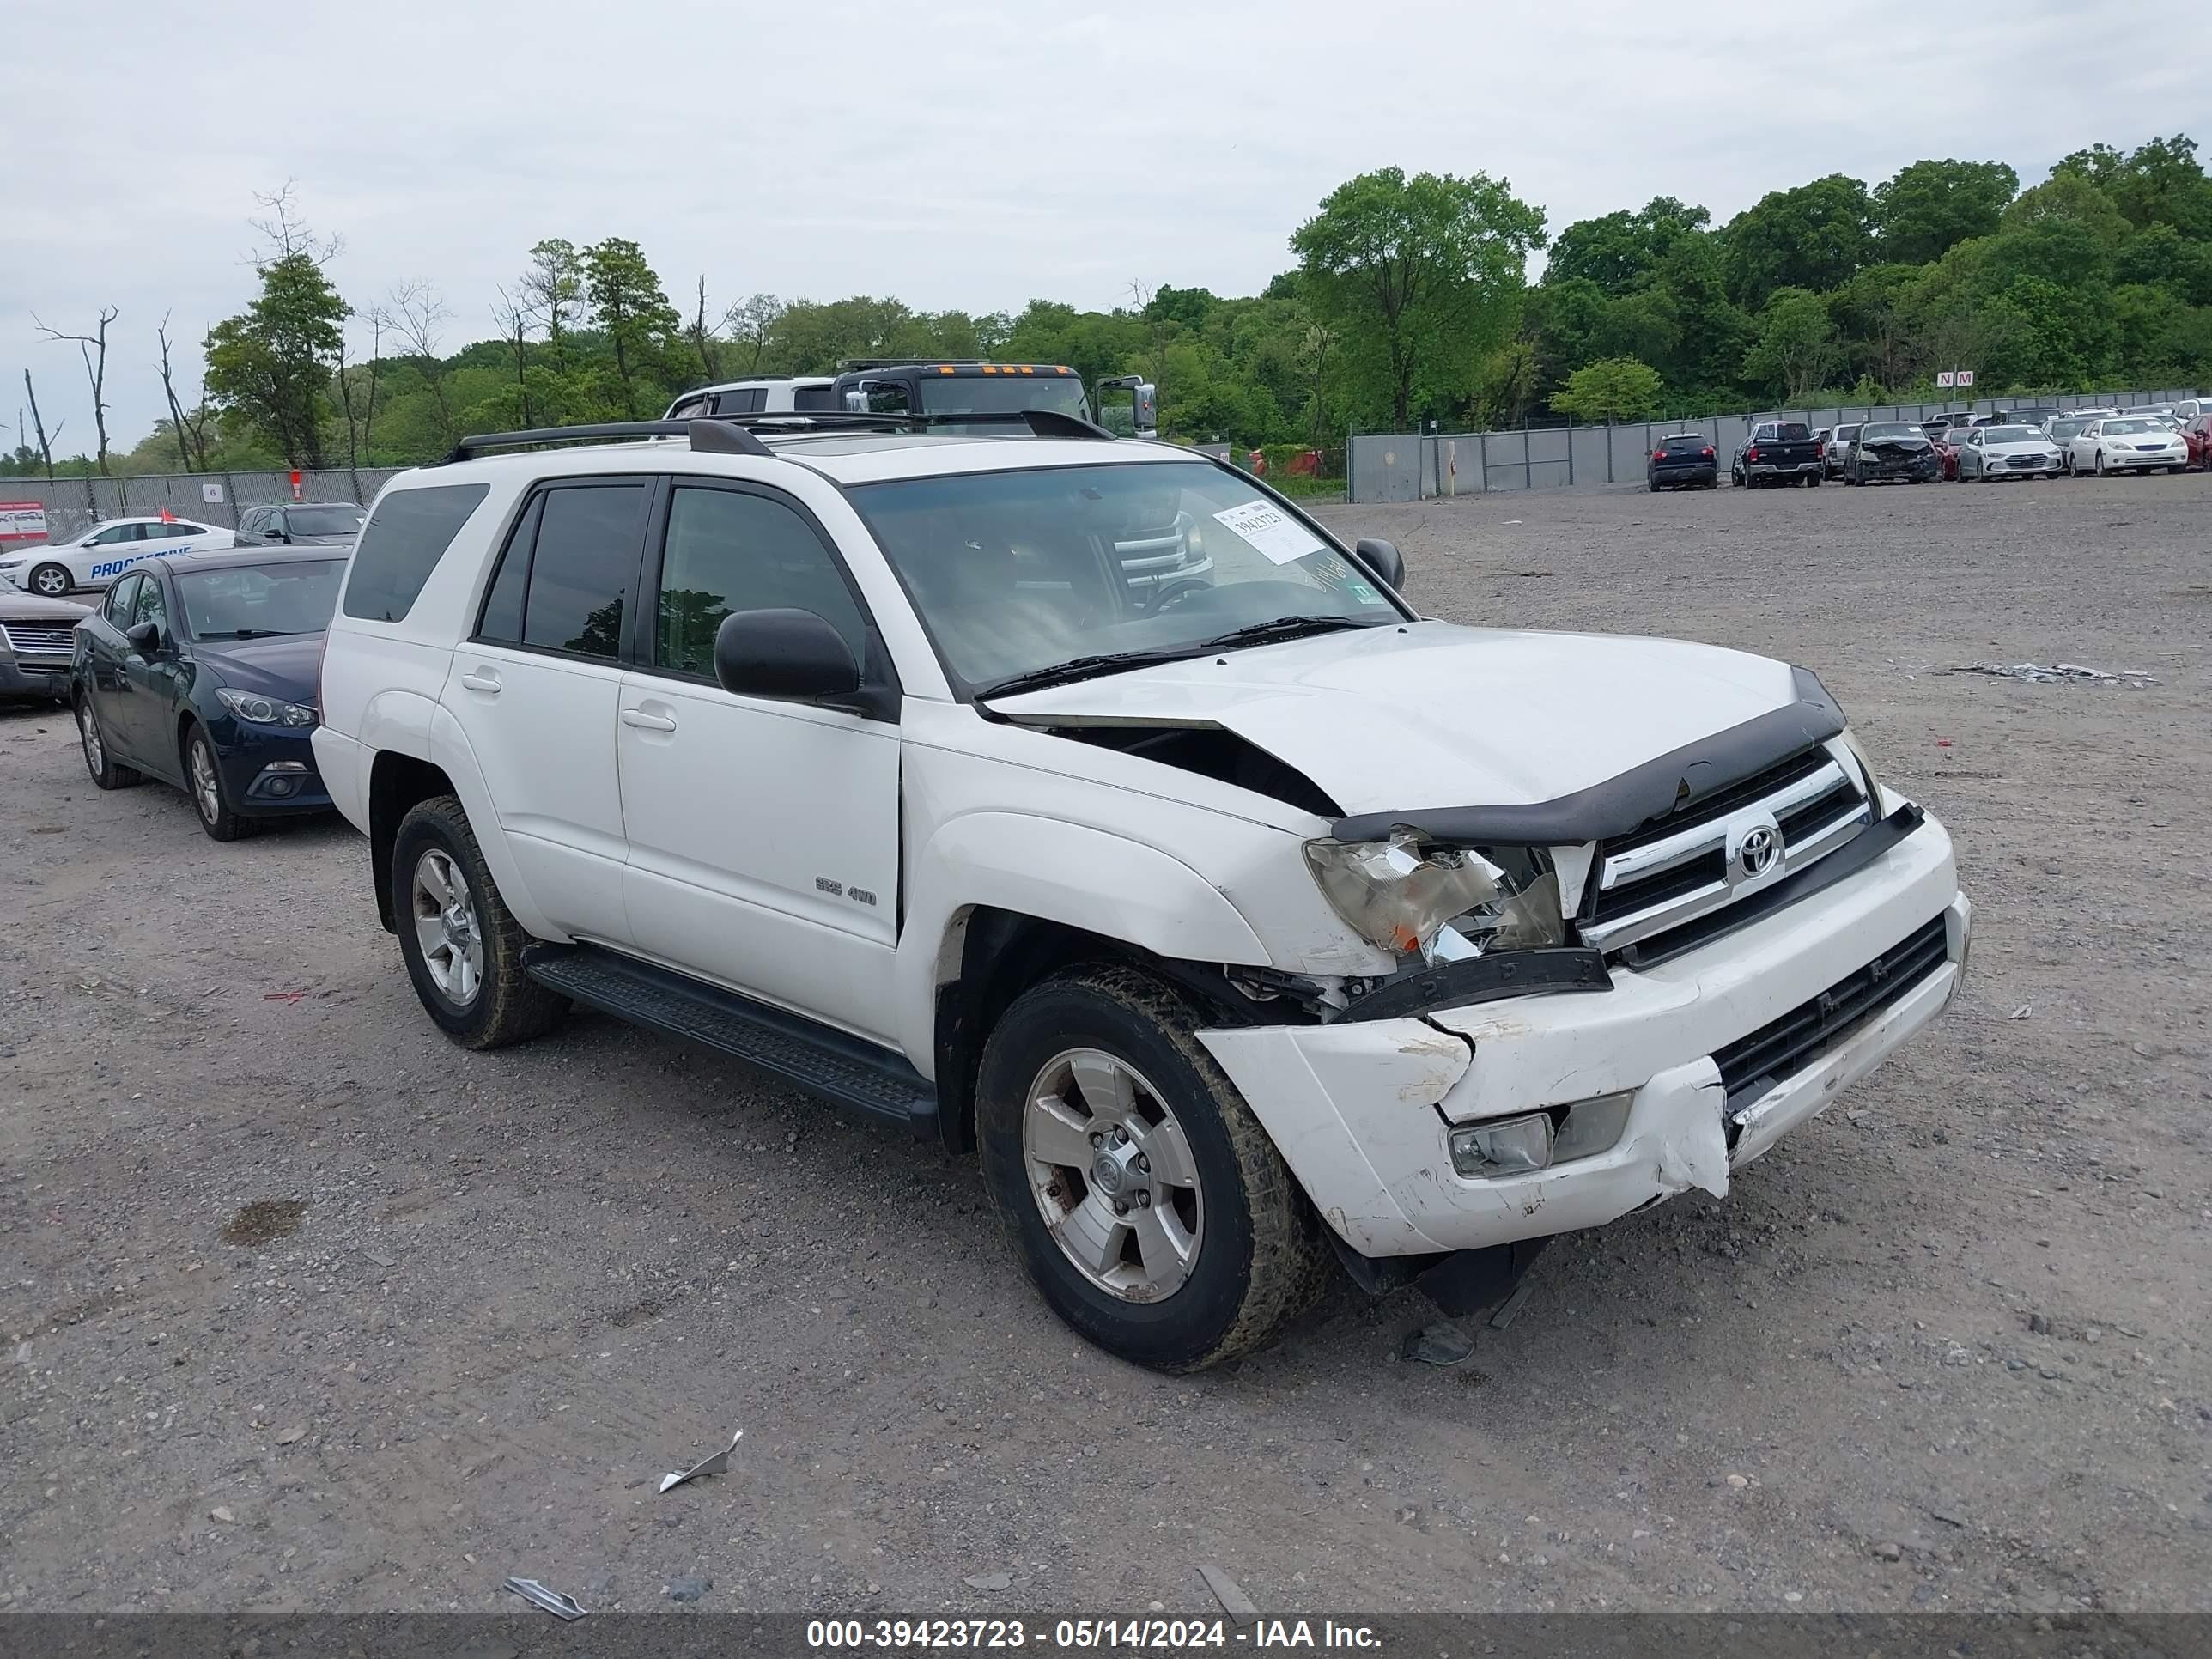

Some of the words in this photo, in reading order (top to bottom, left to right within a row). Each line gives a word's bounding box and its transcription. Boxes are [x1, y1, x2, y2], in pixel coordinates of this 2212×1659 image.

[1941, 374, 1950, 384] N
[1959, 373, 1972, 384] M
[1235, 512, 1283, 534] 39423723
[847, 885, 878, 906] 4WD
